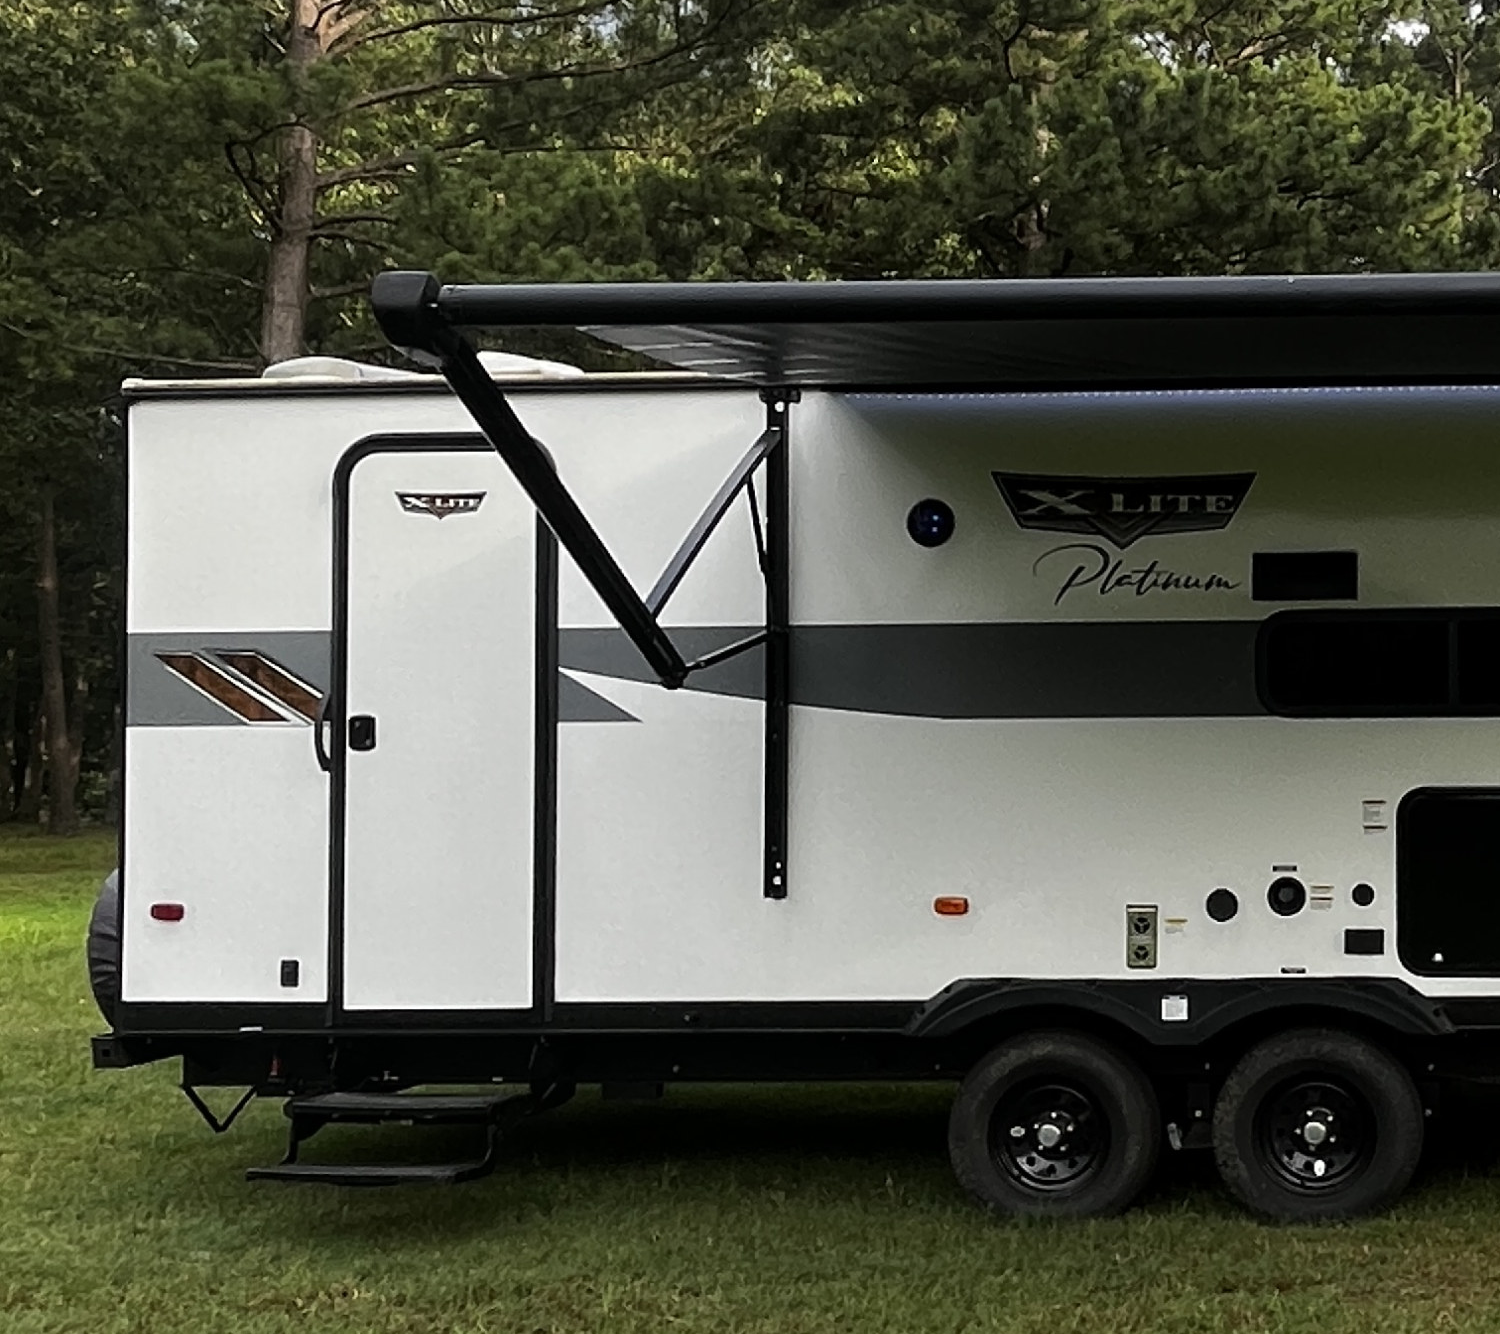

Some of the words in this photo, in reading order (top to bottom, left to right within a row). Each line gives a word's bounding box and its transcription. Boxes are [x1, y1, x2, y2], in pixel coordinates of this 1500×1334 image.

[403, 497, 430, 508] X
[435, 498, 480, 508] LITE
[1017, 489, 1095, 514] X
[1110, 493, 1235, 513] LITE
[1032, 543, 1241, 606] Platinum
